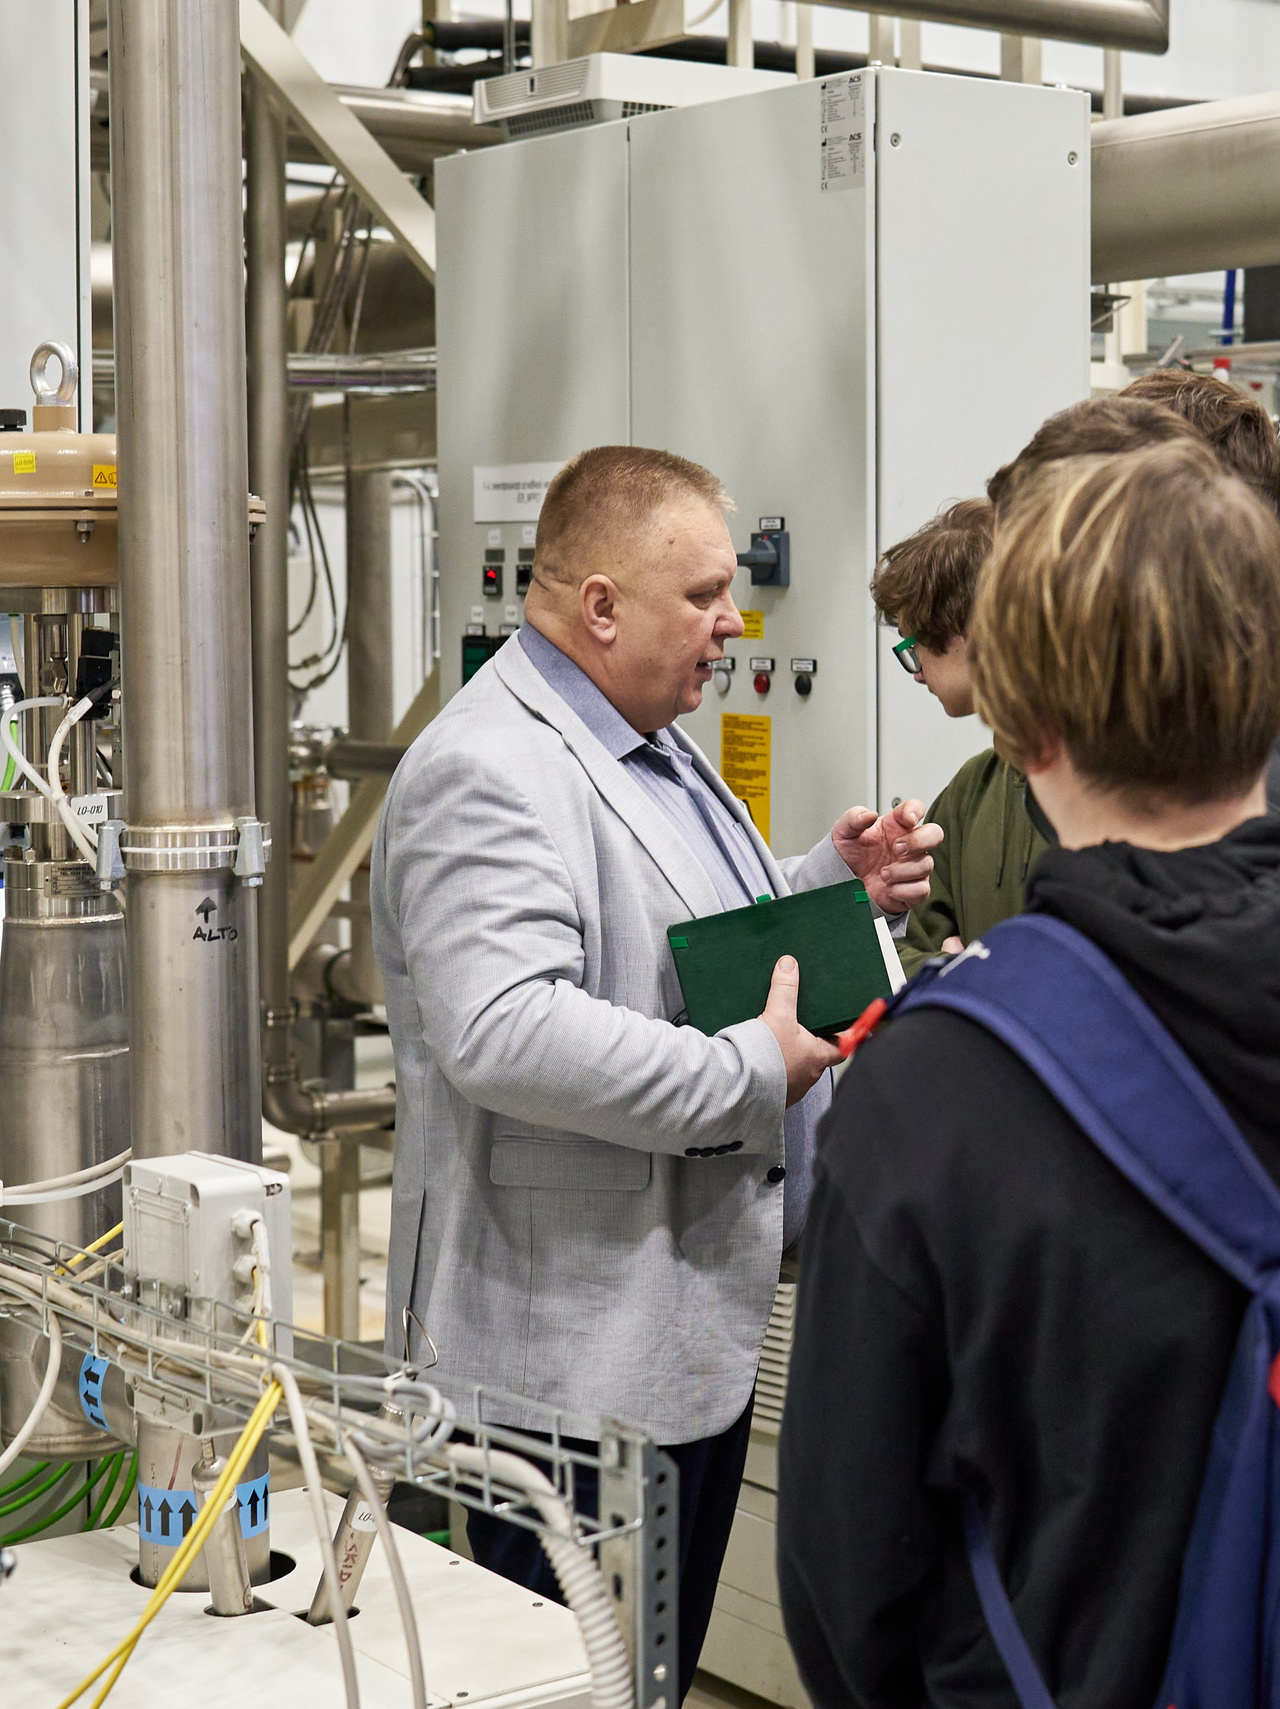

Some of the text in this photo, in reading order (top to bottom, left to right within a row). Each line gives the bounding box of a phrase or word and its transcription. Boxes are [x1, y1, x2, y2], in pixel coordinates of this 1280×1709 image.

[77, 805, 103, 815] LO-010
[193, 926, 238, 942] ALTO
[358, 1511, 375, 1523] LO-
